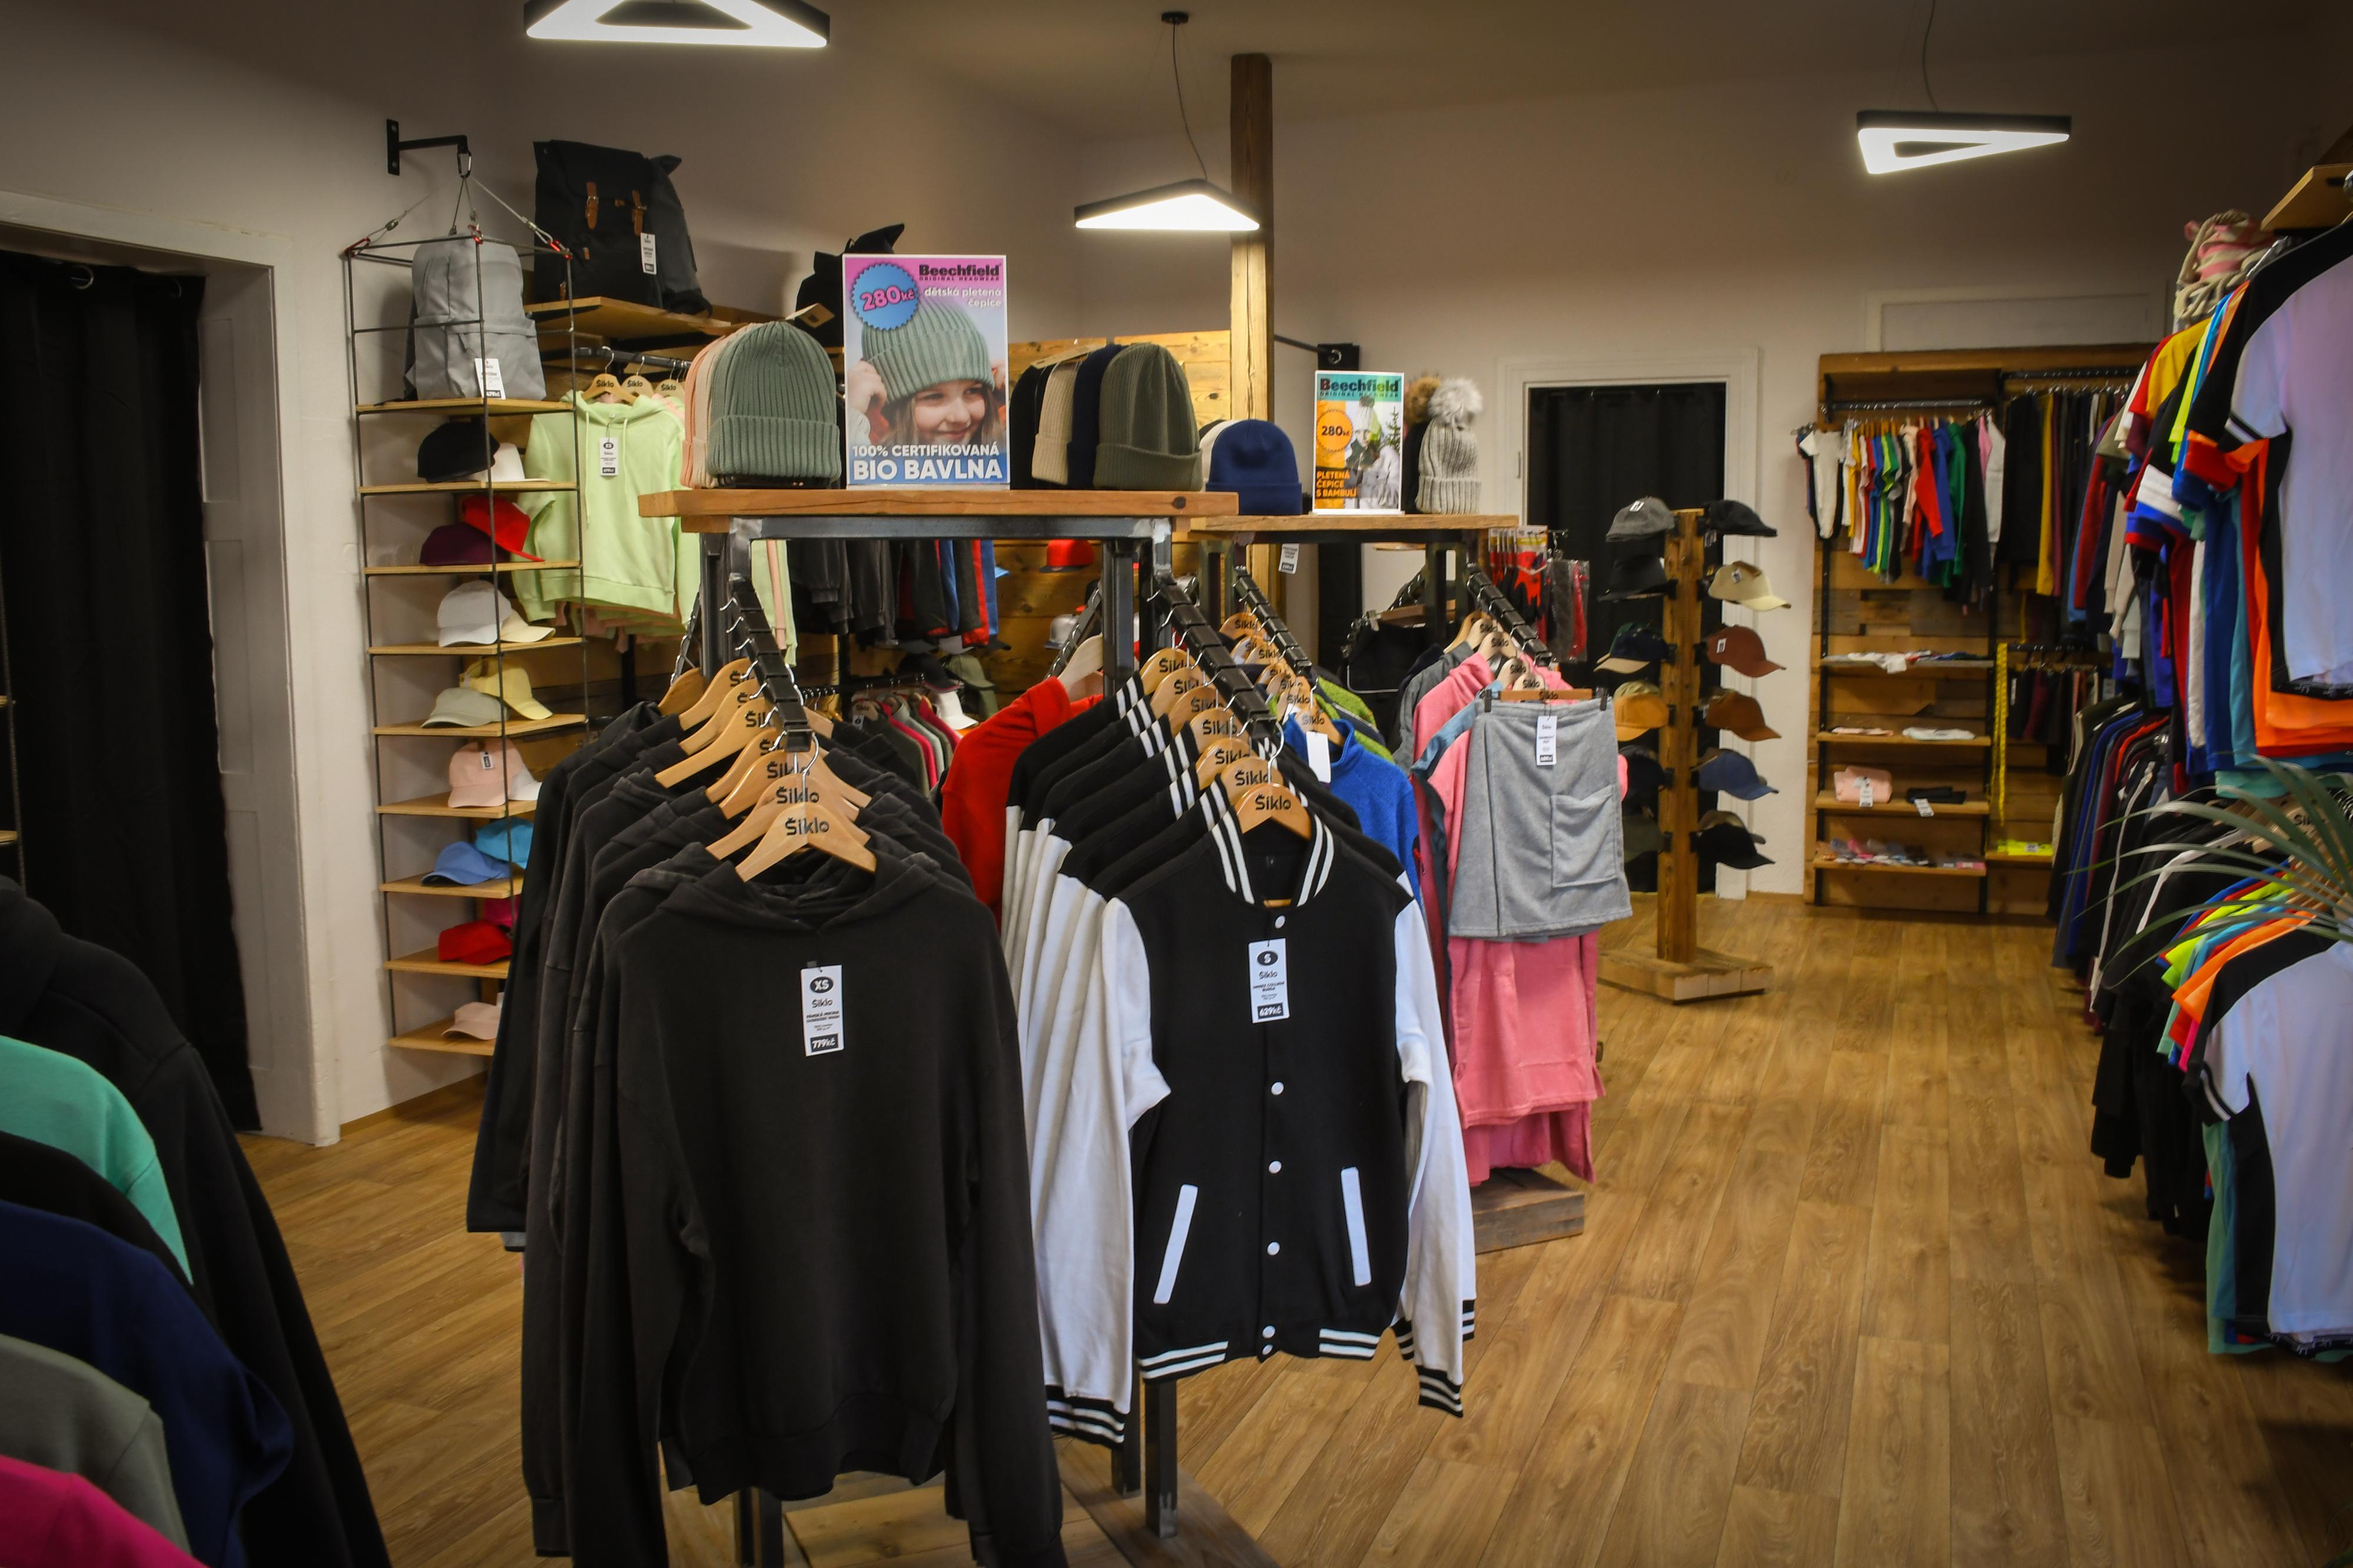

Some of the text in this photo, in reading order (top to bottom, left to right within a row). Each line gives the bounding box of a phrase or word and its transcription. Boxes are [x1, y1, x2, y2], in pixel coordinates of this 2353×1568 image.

[919, 264, 999, 276] Beechfield
[924, 286, 1002, 298] dětská pletená
[968, 298, 1002, 308] čepice
[1320, 379, 1399, 392] Beechfield
[853, 442, 1000, 457] 100% CERTIFIKOVANÁ
[854, 458, 1003, 481] BIO BAVLNA
[1255, 794, 1292, 810] Šiklo
[785, 817, 829, 836] Šiklo
[814, 979, 829, 991] XS
